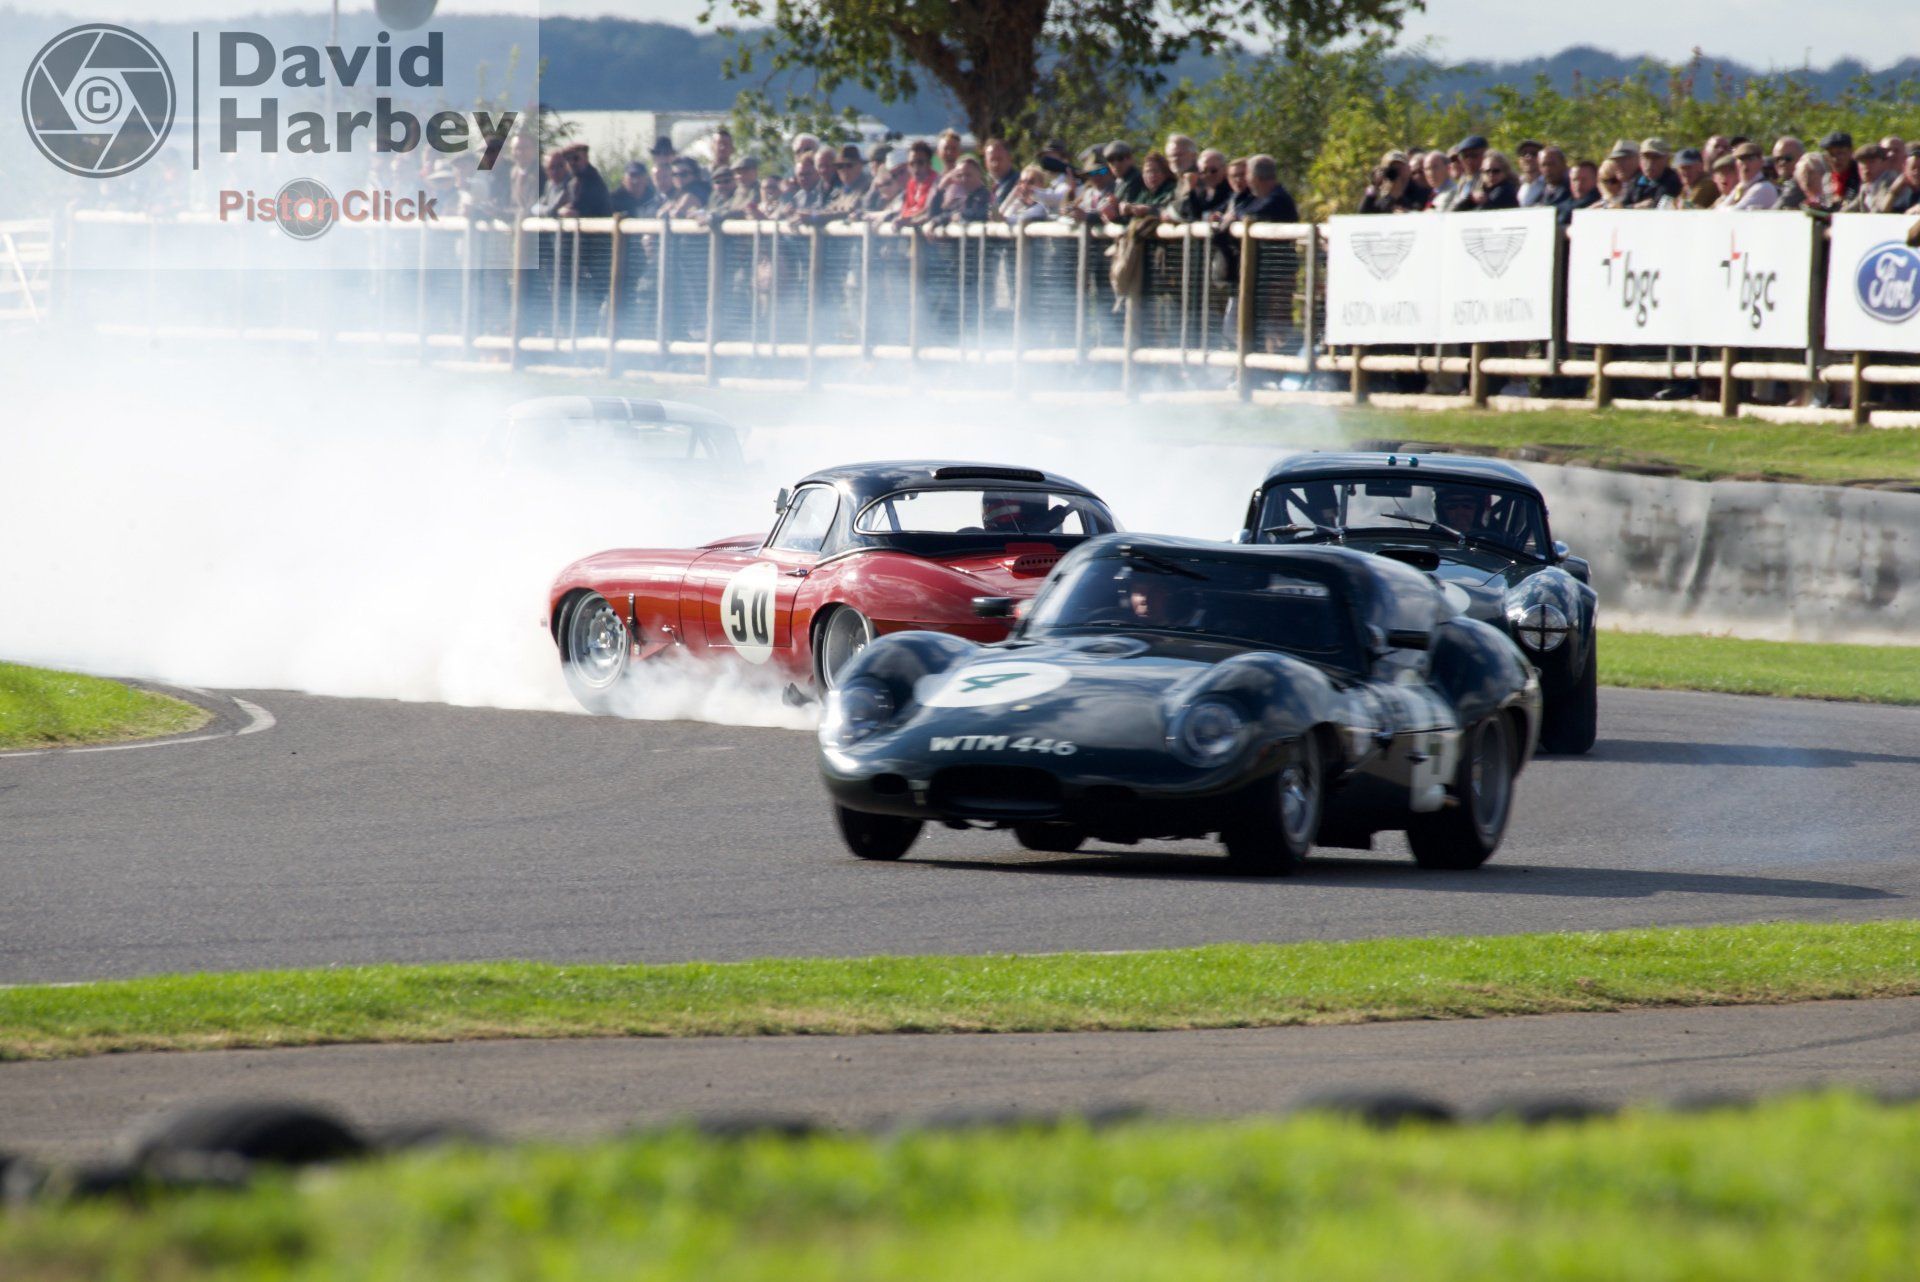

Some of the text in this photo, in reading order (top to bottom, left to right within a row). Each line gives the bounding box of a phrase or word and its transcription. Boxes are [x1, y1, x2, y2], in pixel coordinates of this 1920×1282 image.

[1623, 251, 1660, 328] bgc
[1740, 252, 1777, 330] bgc
[1868, 251, 1918, 309] Ford
[730, 583, 769, 645] 50
[960, 672, 1033, 693] 4
[929, 735, 1078, 756] WTM 446
